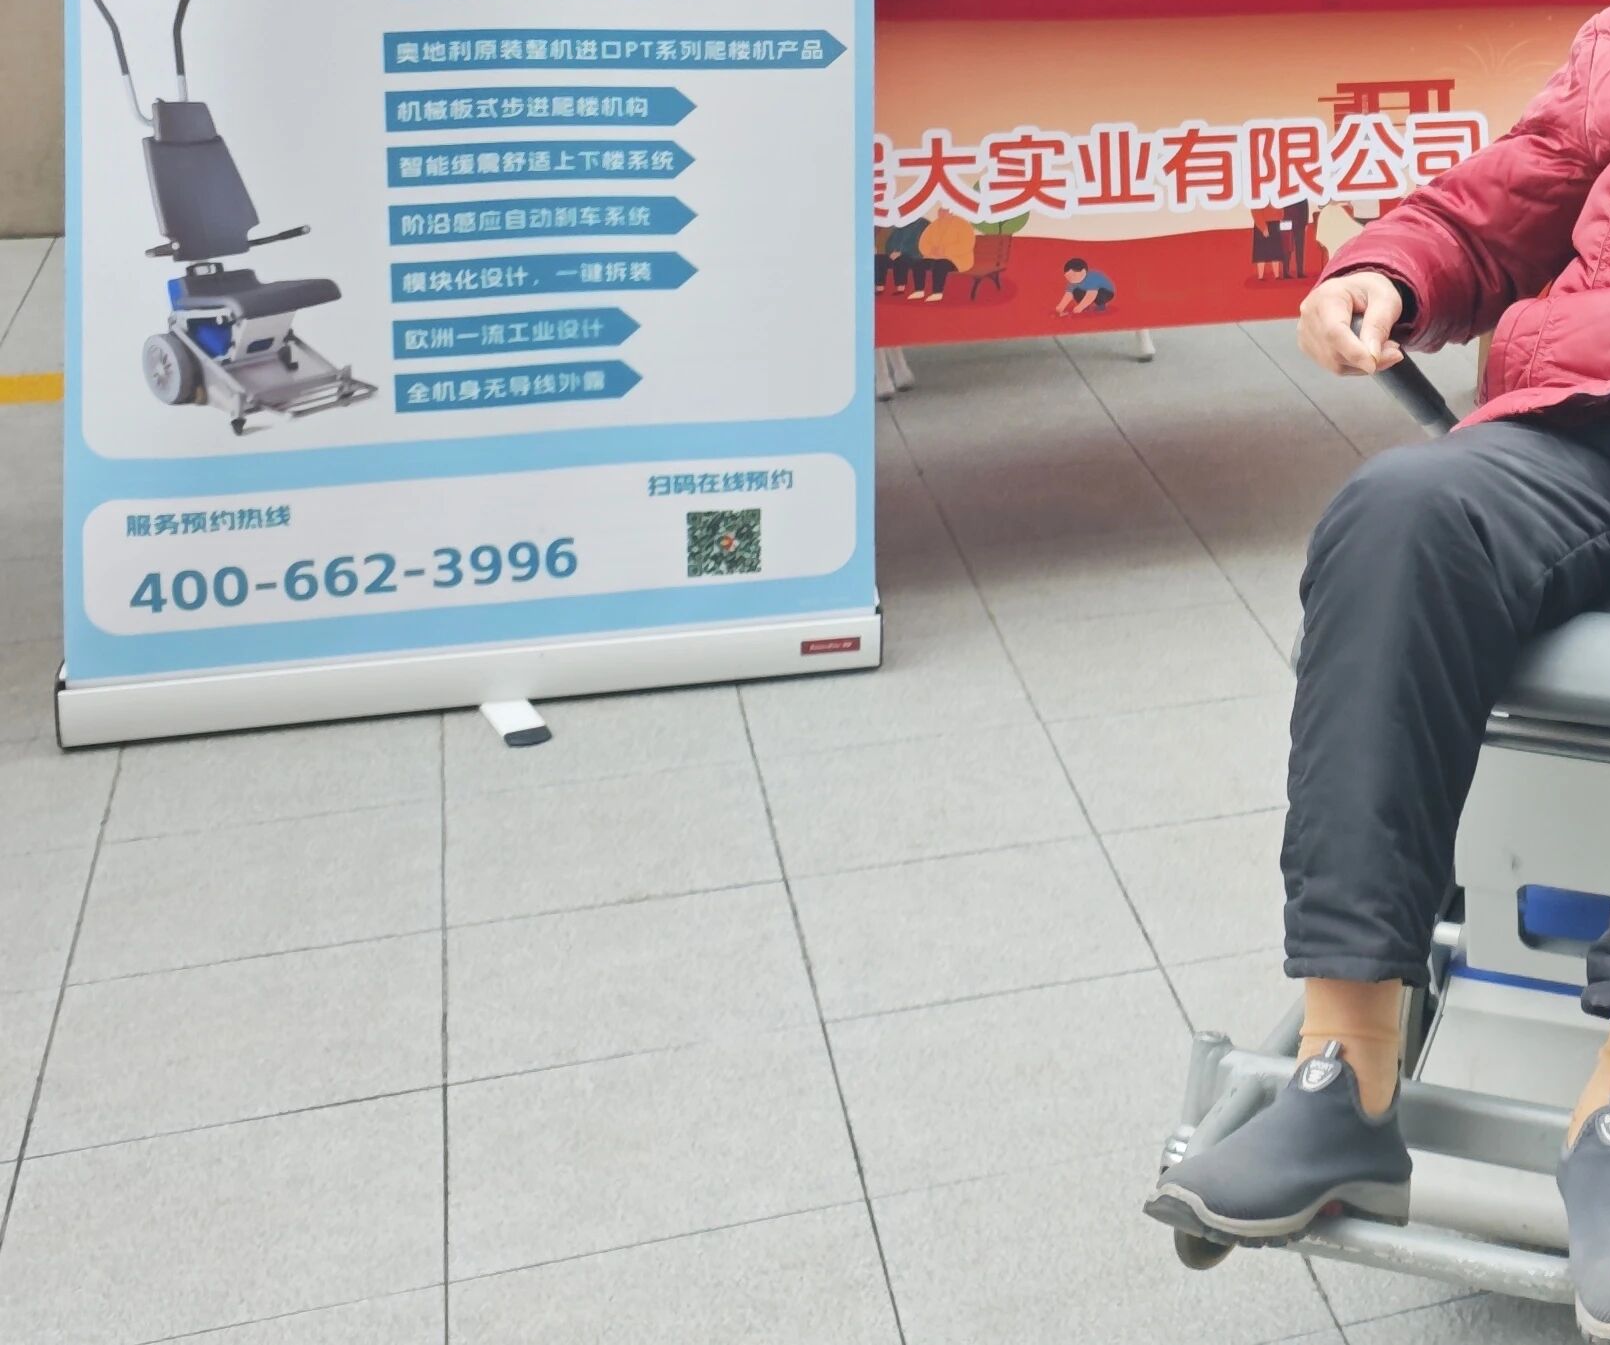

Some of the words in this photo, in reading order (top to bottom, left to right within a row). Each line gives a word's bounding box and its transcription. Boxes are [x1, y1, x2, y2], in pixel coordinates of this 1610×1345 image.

[396, 38, 824, 64] 奥地利原装整机进口PT系列爬楼机产品
[401, 205, 652, 237] 阶沿感应自动刹车系统
[404, 318, 605, 351] 欧洲一流工业设计
[406, 369, 606, 405] 全机身无导线外露
[648, 469, 793, 497] 扫码在线预约
[126, 504, 292, 538] 服务预约热线
[129, 536, 578, 614] 400-662-3996
